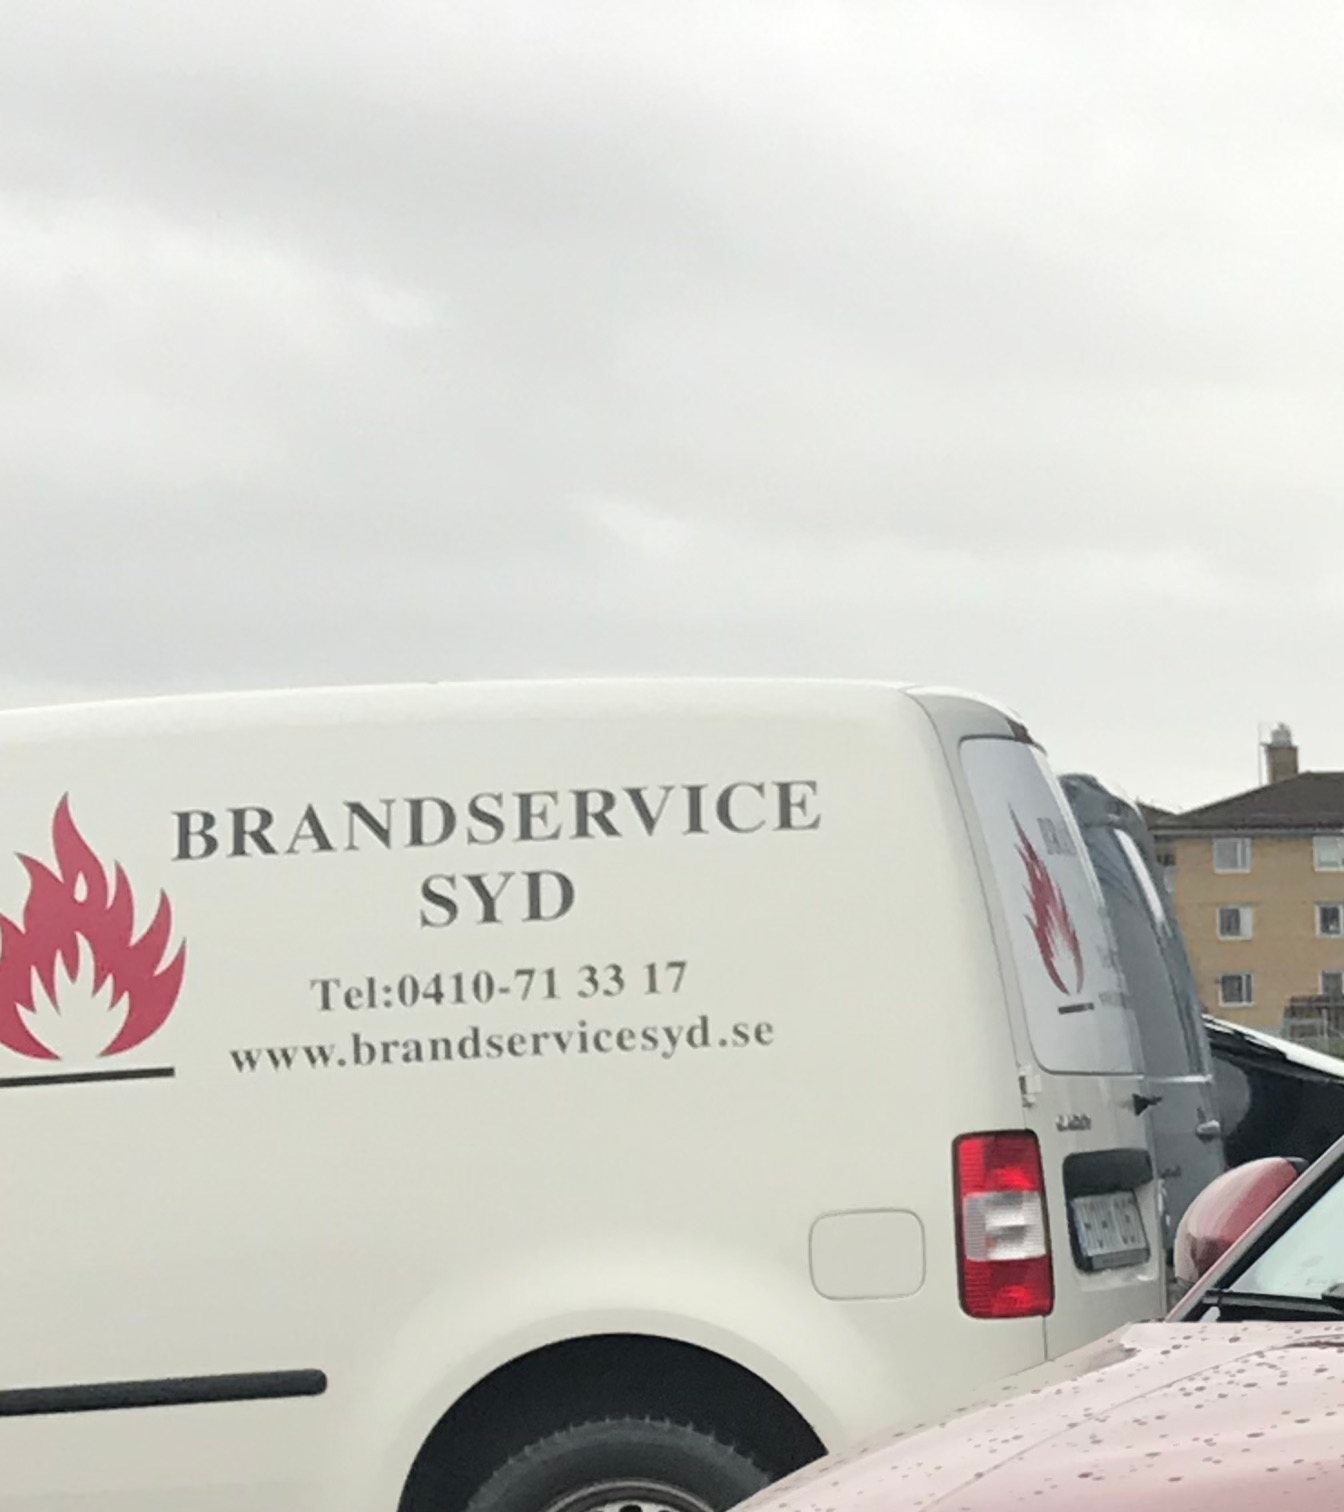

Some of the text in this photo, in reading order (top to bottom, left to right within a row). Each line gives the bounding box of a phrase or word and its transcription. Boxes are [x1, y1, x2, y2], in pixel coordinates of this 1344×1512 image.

[172, 779, 822, 861] BRANDSERVICE
[419, 869, 576, 928] SYD
[310, 960, 688, 1011] Tel:0410-71 33 17
[229, 1014, 775, 1074] www.brandservicesyd.se
